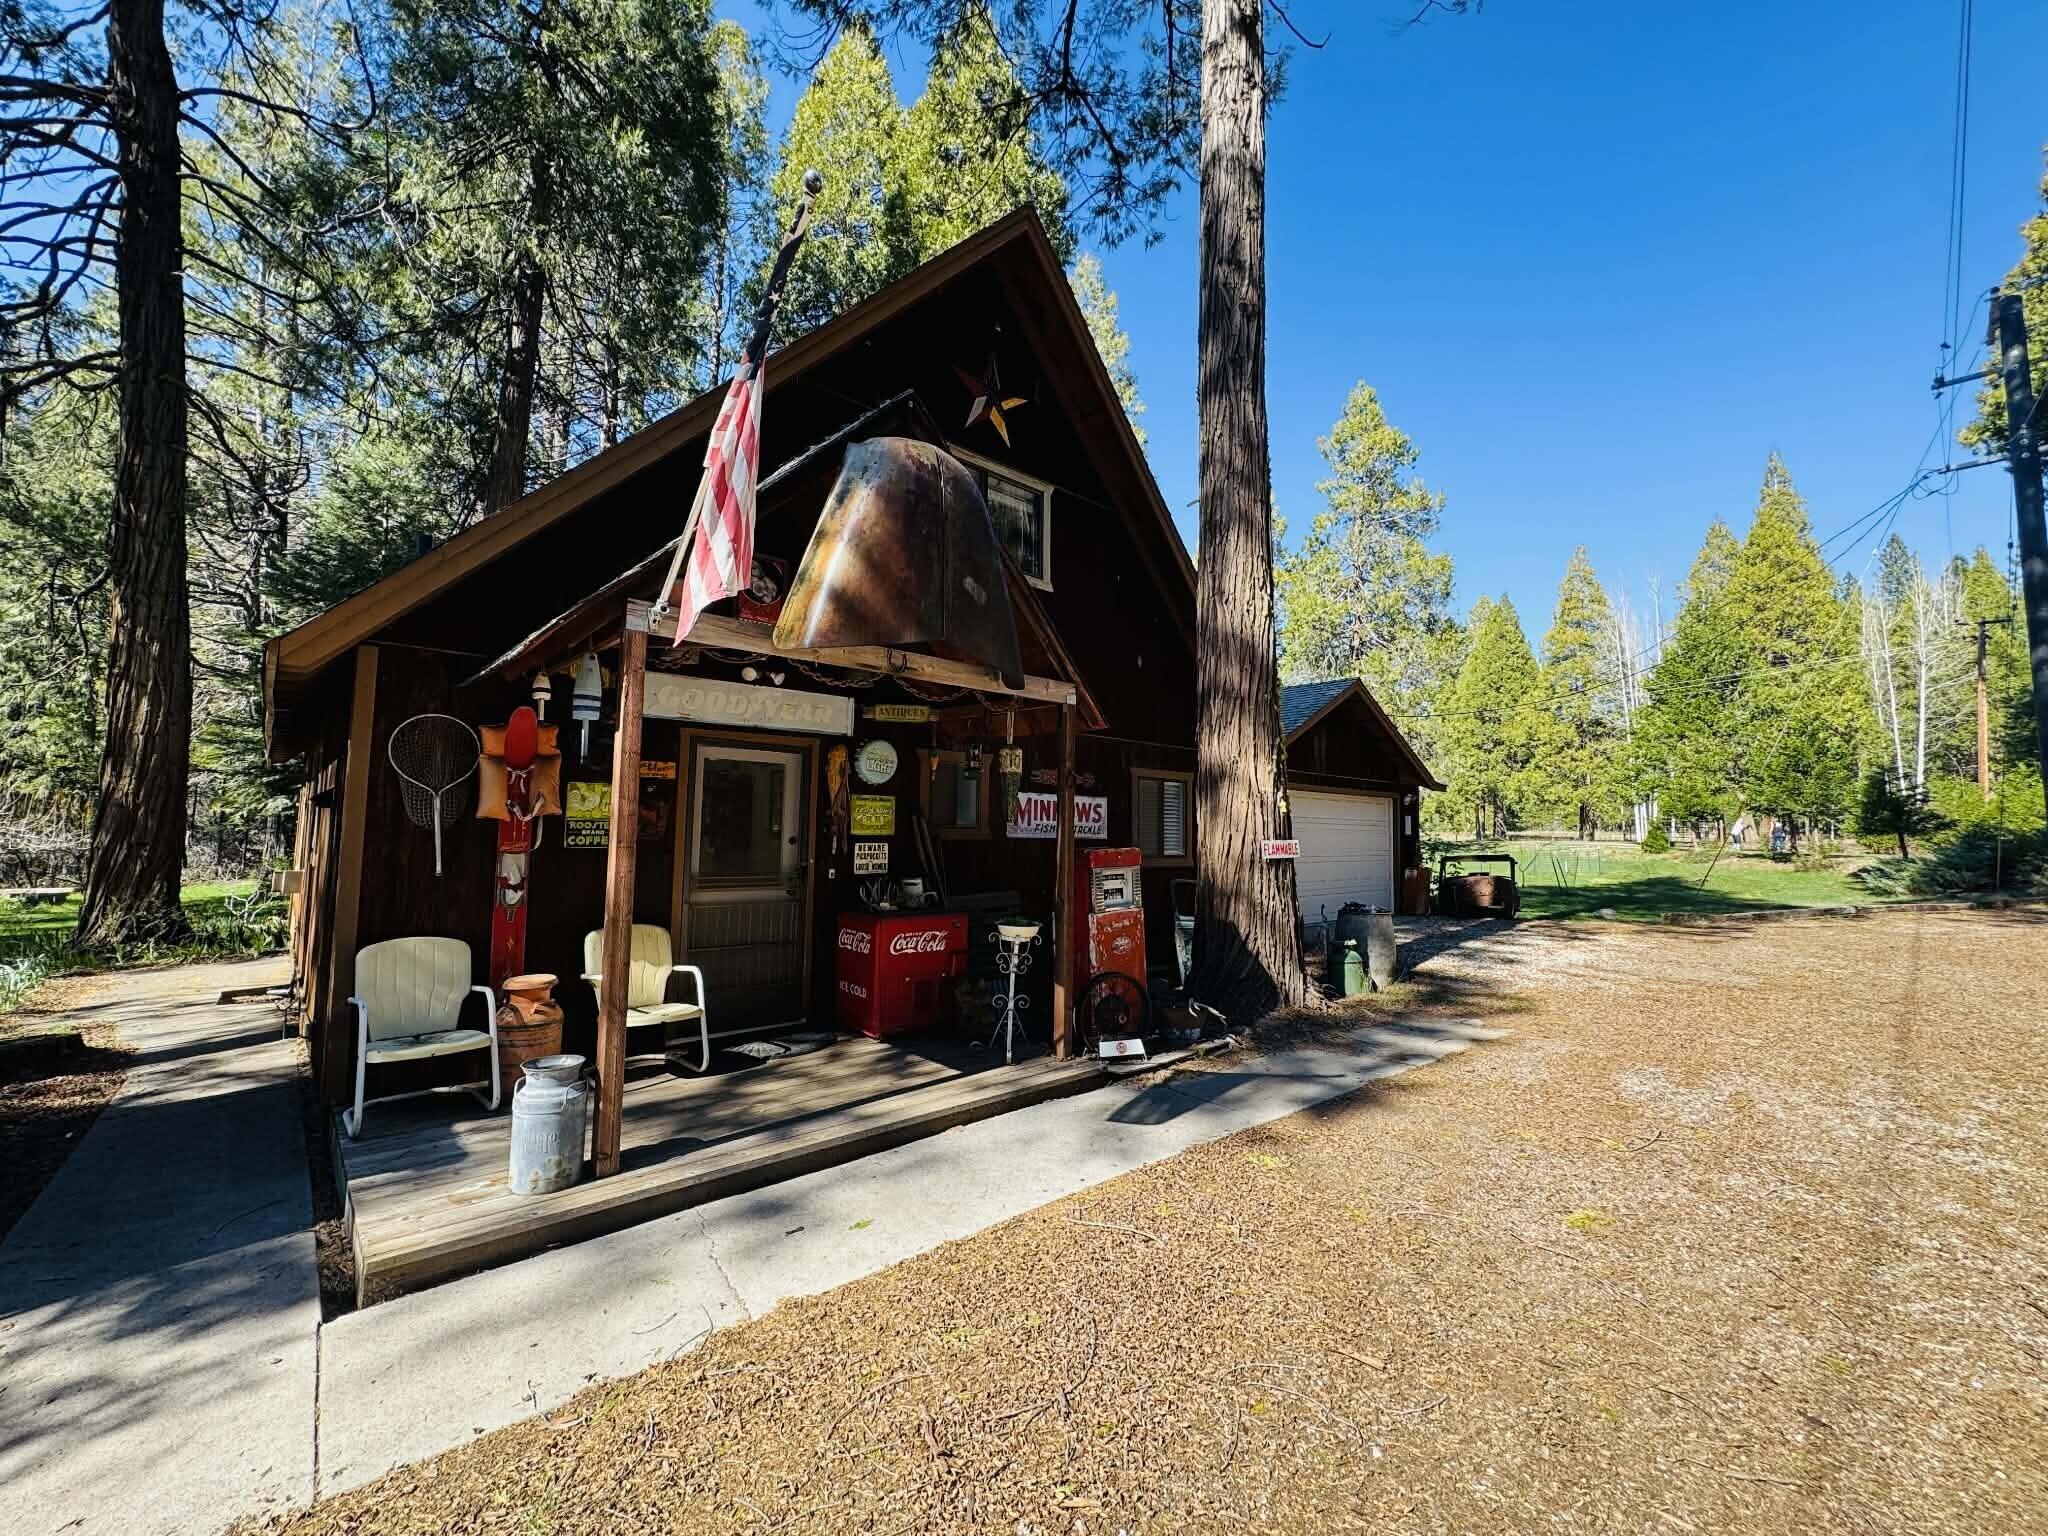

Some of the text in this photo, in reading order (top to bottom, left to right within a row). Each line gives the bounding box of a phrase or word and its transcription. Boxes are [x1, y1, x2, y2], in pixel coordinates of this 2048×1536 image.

[879, 706, 926, 718] ANTIQUES
[865, 759, 892, 774] LIGHT
[1015, 798, 1103, 826] MINWS
[568, 821, 609, 830] ROOSTE
[1034, 824, 1057, 833] FISH
[567, 835, 609, 846] COFFE
[857, 844, 886, 852] BEWARE
[1263, 842, 1299, 856] FLAMMABLE
[839, 979, 867, 999] ICE COLD
